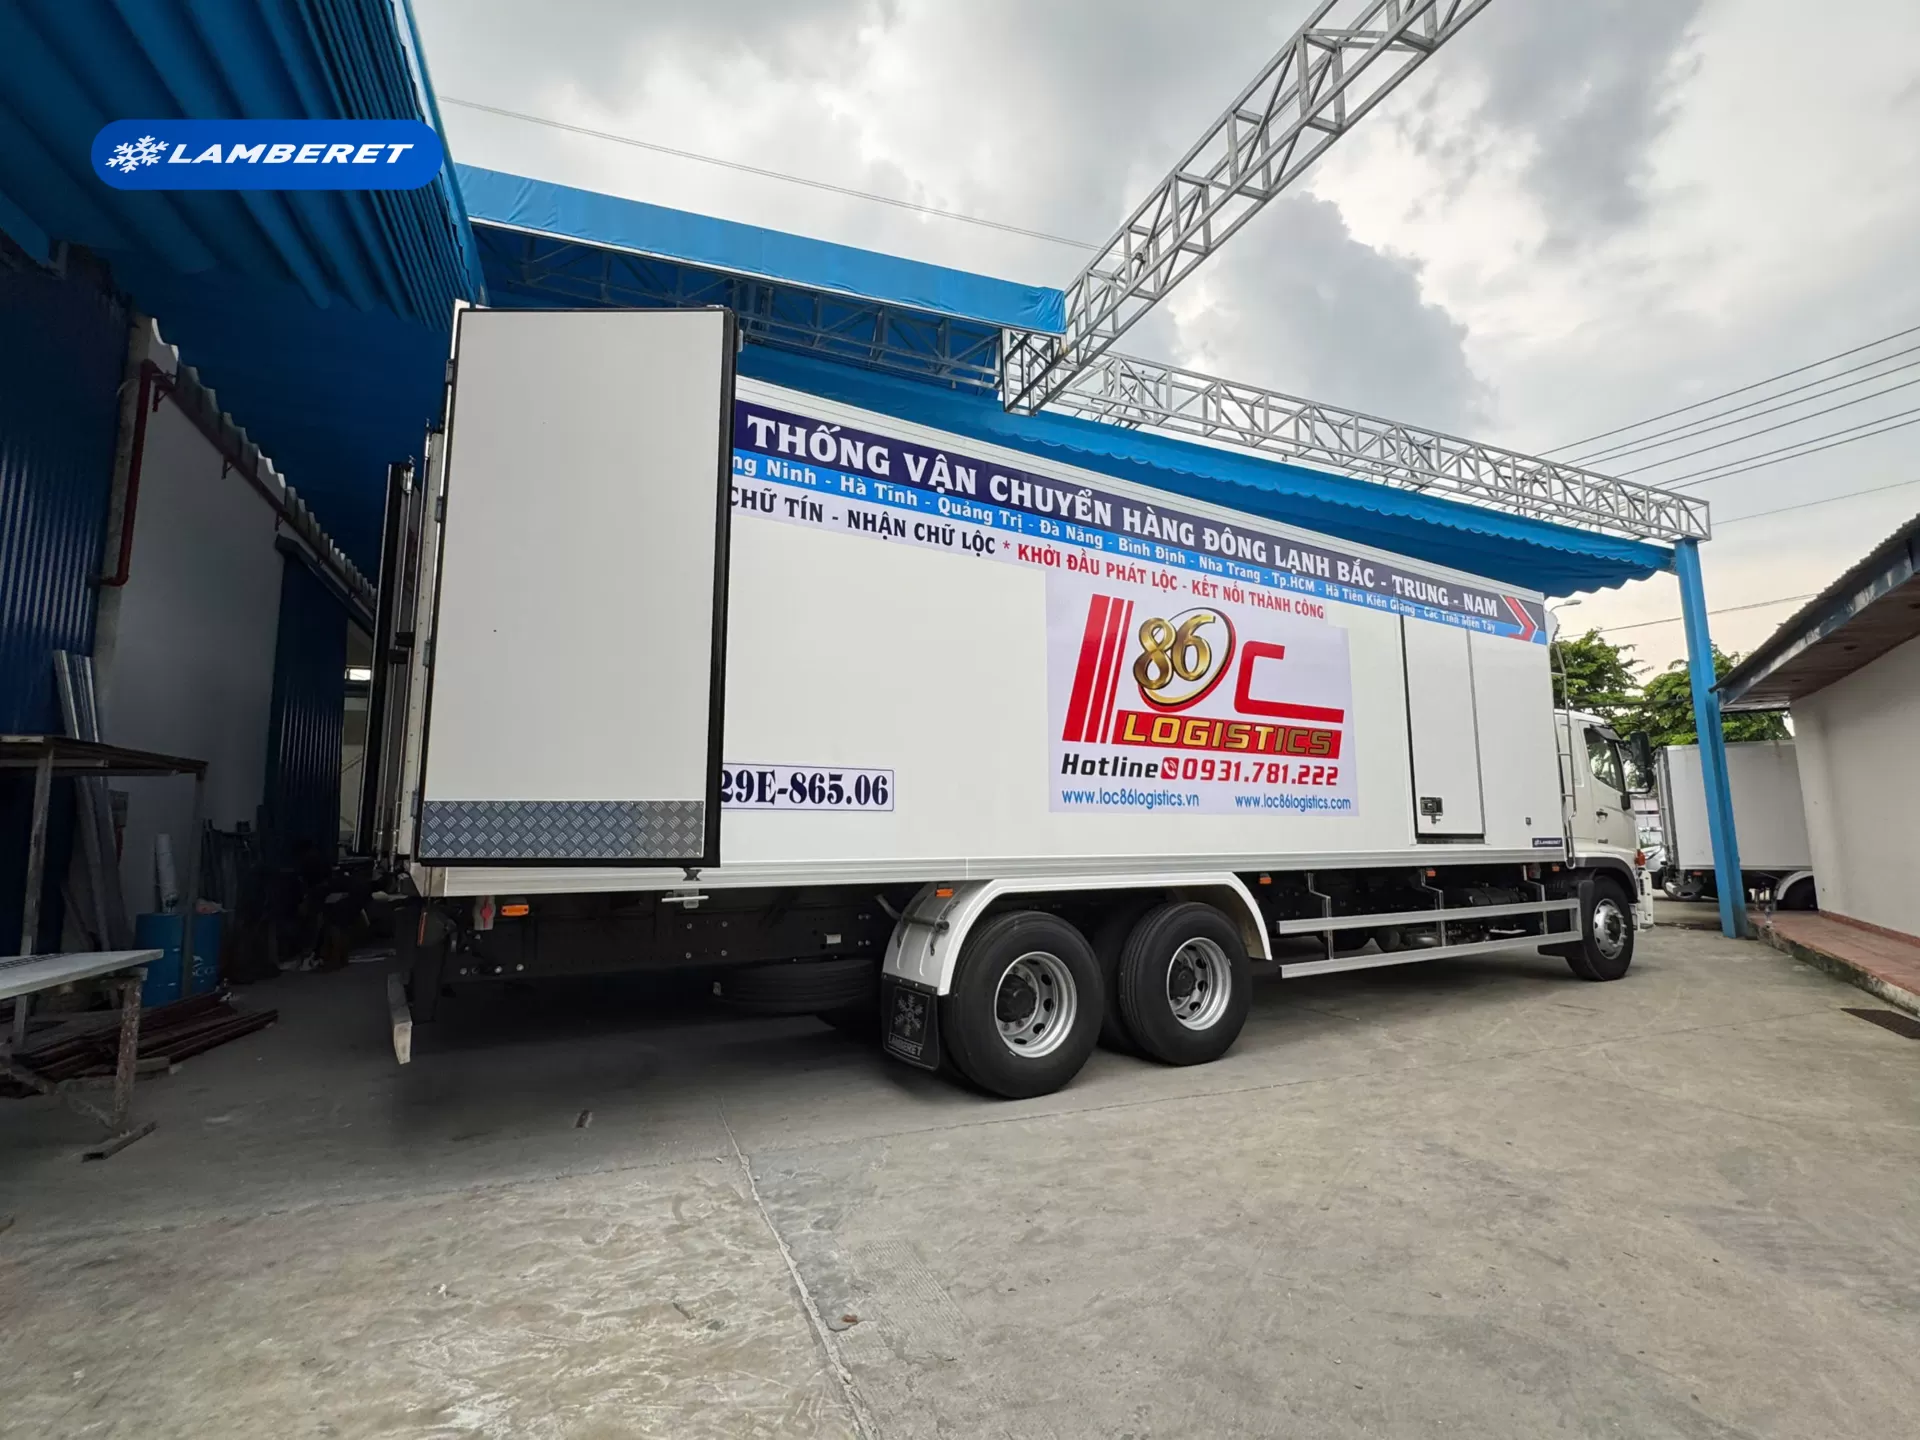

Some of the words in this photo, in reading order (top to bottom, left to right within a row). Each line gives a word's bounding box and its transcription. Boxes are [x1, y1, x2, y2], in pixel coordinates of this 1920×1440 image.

[747, 414, 890, 476] THỐNG
[903, 453, 977, 495] VẬN
[989, 474, 1111, 527] CHUYỂN
[1123, 506, 1195, 547] HÀNG
[1202, 527, 1266, 563] ĐÔNG
[1273, 545, 1330, 578] LẠNH
[1337, 559, 1375, 588] BẮC
[1392, 574, 1449, 606] TRUNG
[1463, 592, 1498, 618] NAM
[767, 459, 816, 485] Ninh
[840, 476, 867, 496] Hà
[874, 483, 918, 506] Tĩnh
[938, 496, 993, 526] Quảng
[999, 511, 1022, 534] Trị
[1039, 518, 1060, 537] Đà
[1119, 537, 1150, 557] Bình
[1155, 546, 1186, 565] Định
[1199, 557, 1223, 573] Nha
[1226, 562, 1261, 584] Trang
[1272, 572, 1315, 592] Tp.HCM
[1325, 584, 1339, 598] Hà
[731, 486, 777, 513] CHỮ
[784, 494, 823, 523] TÍN
[847, 509, 906, 540] NHẬN
[914, 523, 955, 547] CHỮ
[962, 529, 996, 557] LỘC
[1018, 541, 1061, 568] KHỞI
[1067, 548, 1100, 575] ĐẦU
[1106, 562, 1147, 585] PHÁT
[1152, 568, 1178, 594] LỘC
[1192, 573, 1219, 599] KẾT
[1222, 578, 1245, 604] NỐI
[1249, 589, 1291, 613] THÀNH
[1294, 598, 1324, 619] CÔNG
[1133, 614, 1217, 691] 86
[1122, 713, 1333, 756] LOGISTICS
[721, 769, 889, 806] 29E-865.06
[1061, 753, 1159, 778] Hotline
[1182, 757, 1339, 786] 0931.781.222
[1061, 787, 1200, 810] www.loc86logistics.vn
[1235, 793, 1351, 812] www.loc86logistics.com
